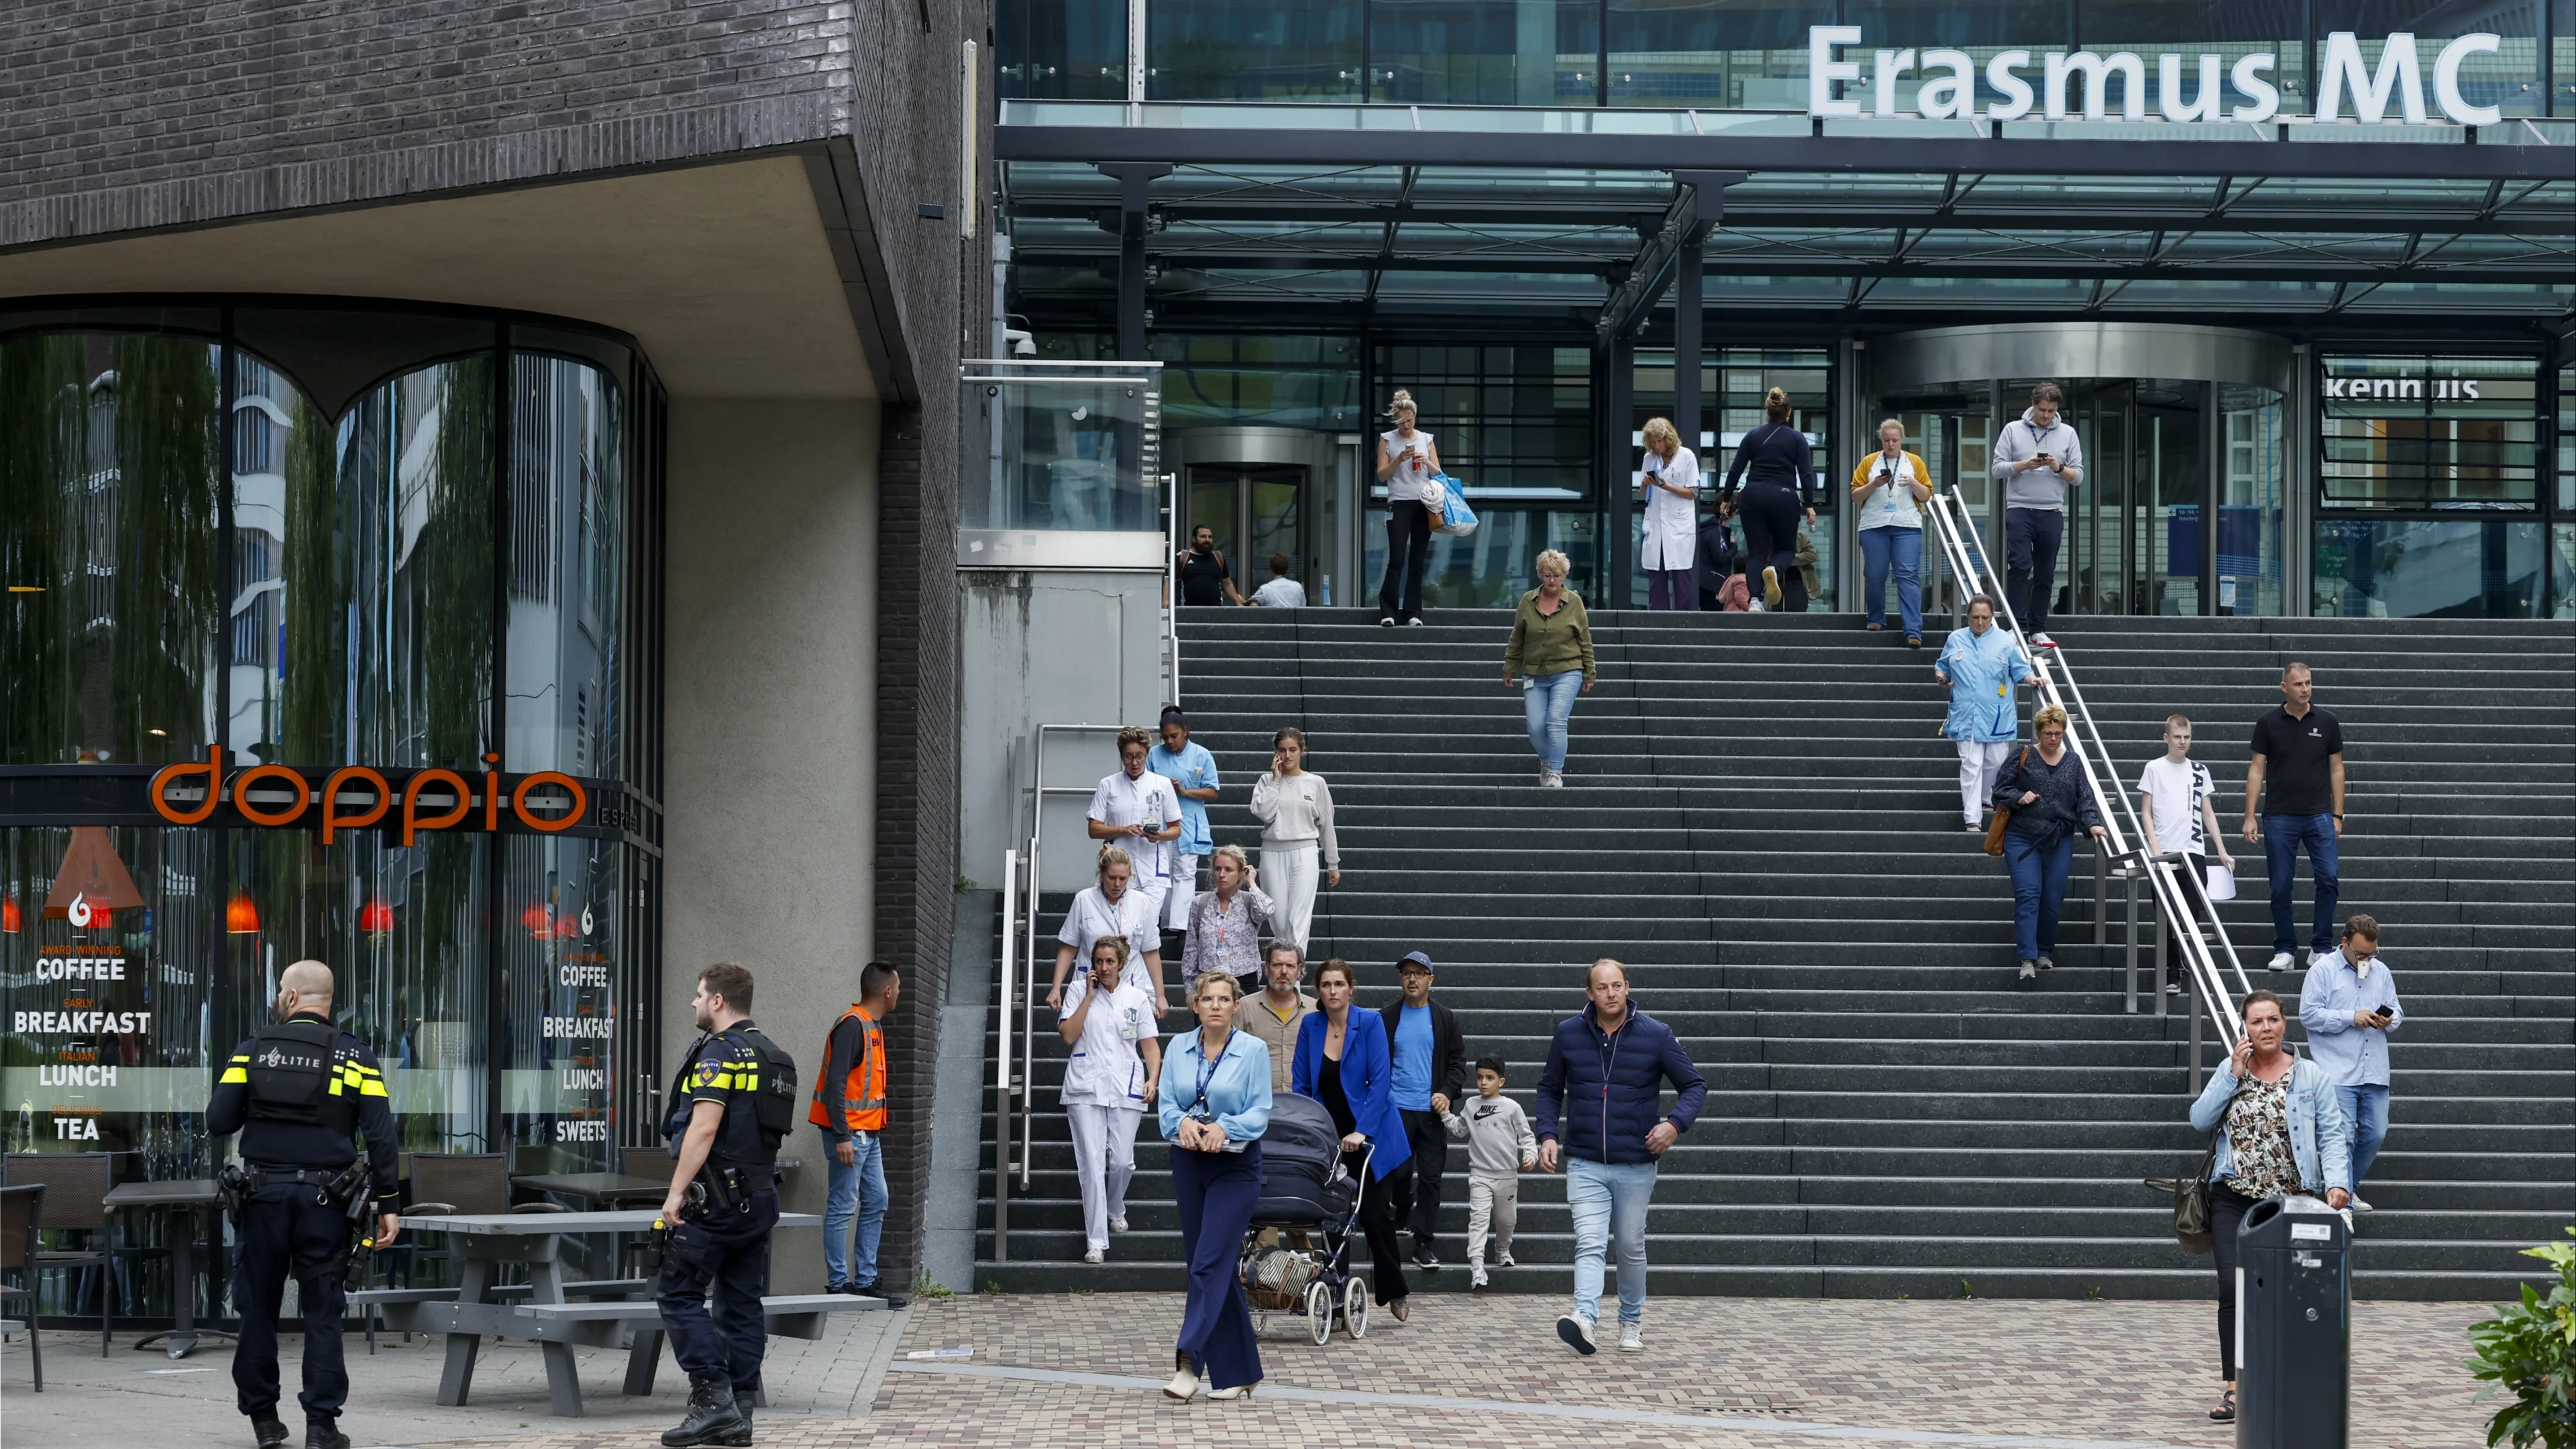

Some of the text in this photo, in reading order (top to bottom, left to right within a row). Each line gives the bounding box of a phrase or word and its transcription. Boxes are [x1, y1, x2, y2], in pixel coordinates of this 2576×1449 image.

[1809, 25, 2502, 126] Erasmus MC
[150, 745, 586, 847] doppio
[2190, 761, 2205, 843] BALLIN
[40, 945, 121, 956] AWARD-WINNING
[36, 958, 125, 980] COFFEE
[560, 965, 606, 987] COFFEE
[64, 998, 93, 1008] EARLY
[15, 1012, 151, 1034] BREAKFAST
[543, 1017, 614, 1039] BREAKFAST
[59, 1051, 96, 1061] ITALIAN
[258, 1047, 321, 1068] POLITIE
[40, 1065, 117, 1087] LUNCH
[563, 1069, 603, 1090] LUNCH
[52, 1105, 102, 1115] DELICIOUS
[1478, 1105, 1498, 1114] NIKE
[54, 1118, 99, 1140] TEA
[556, 1120, 606, 1142] SWEETS
